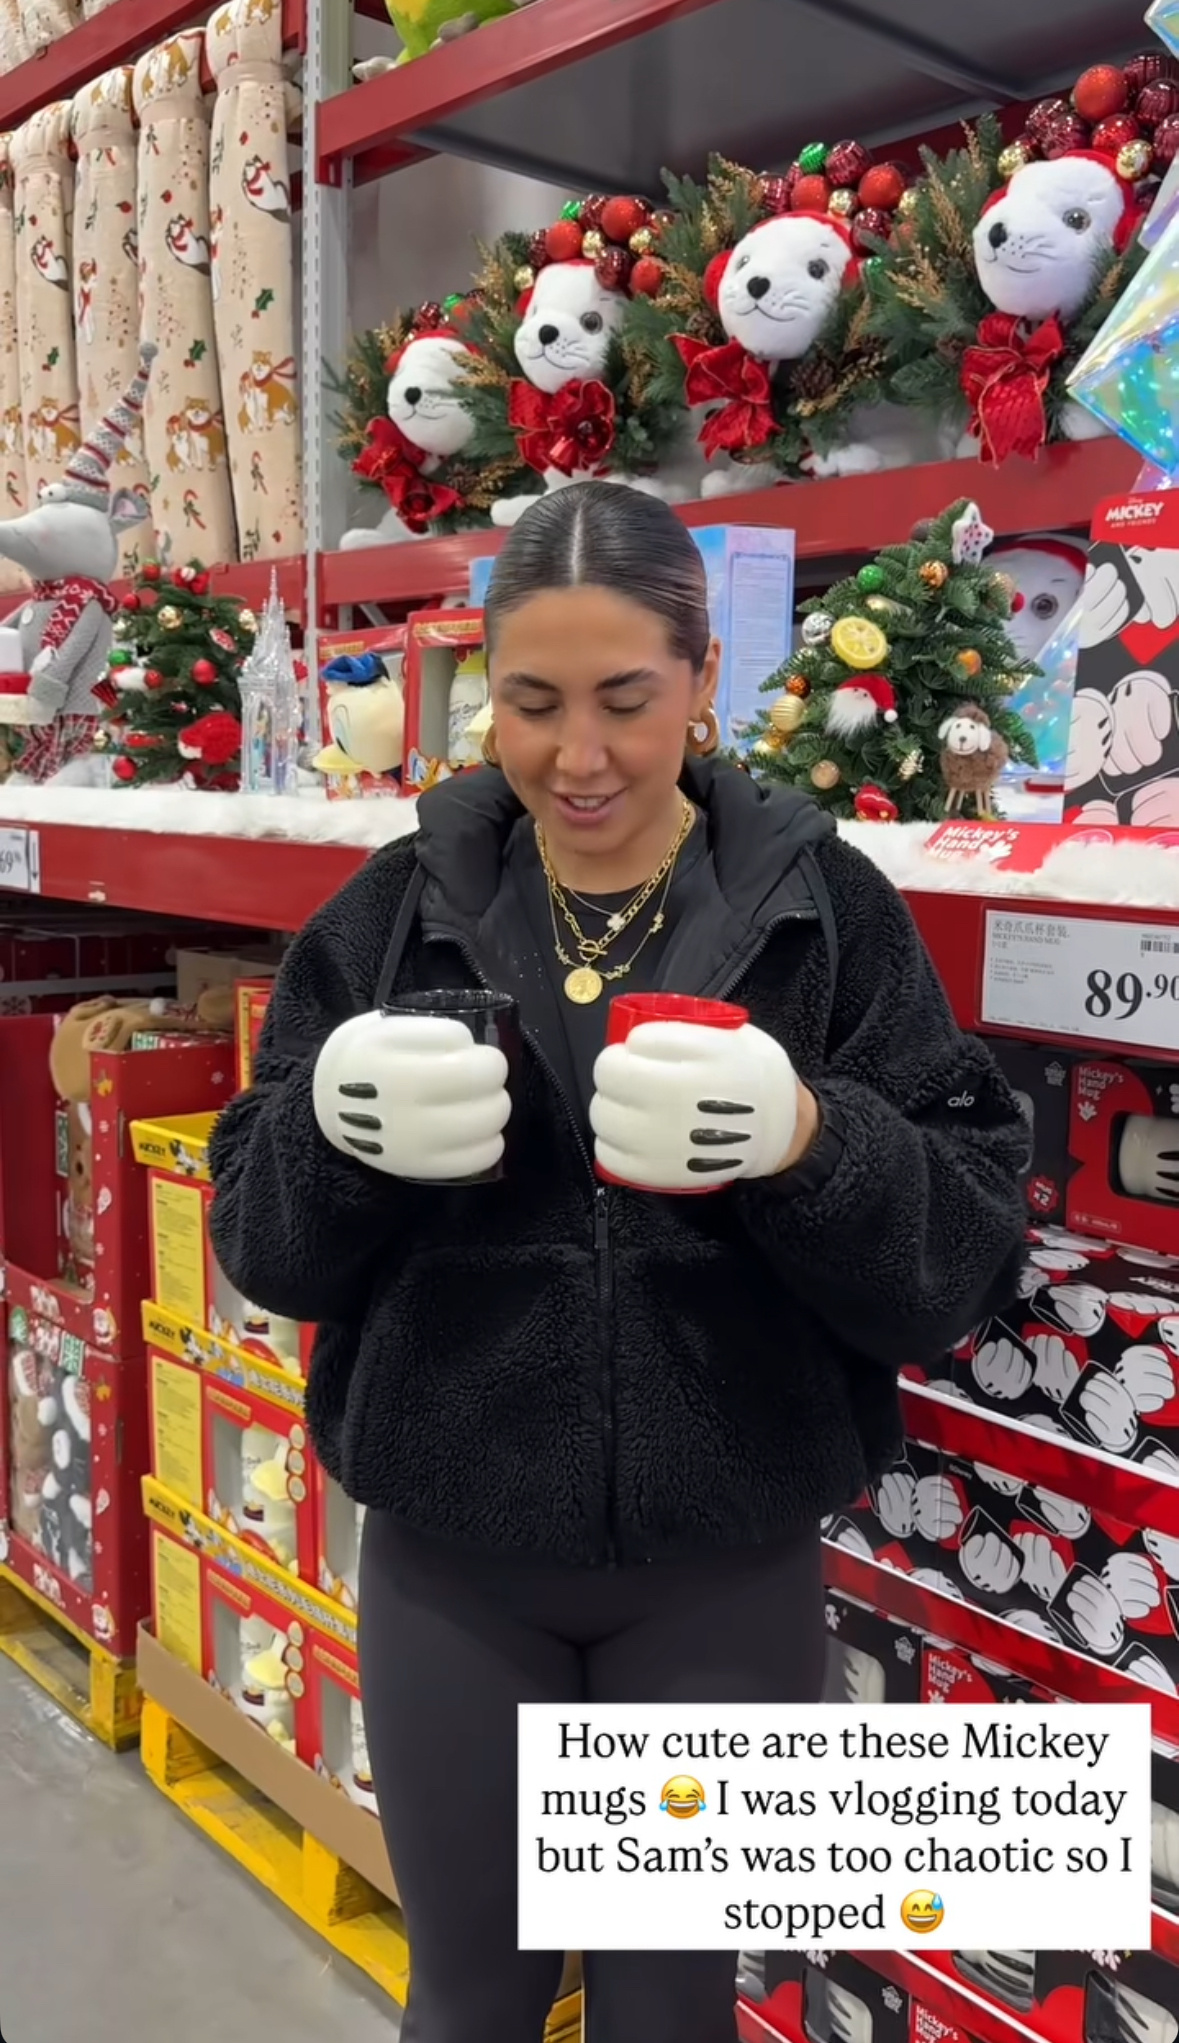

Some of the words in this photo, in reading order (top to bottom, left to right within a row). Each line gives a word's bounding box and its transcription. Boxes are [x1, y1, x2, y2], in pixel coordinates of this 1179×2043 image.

[1105, 501, 1165, 522] MICKEY
[944, 825, 1020, 842] Mickey's
[933, 836, 981, 851] Hand
[947, 1089, 975, 1107] alo
